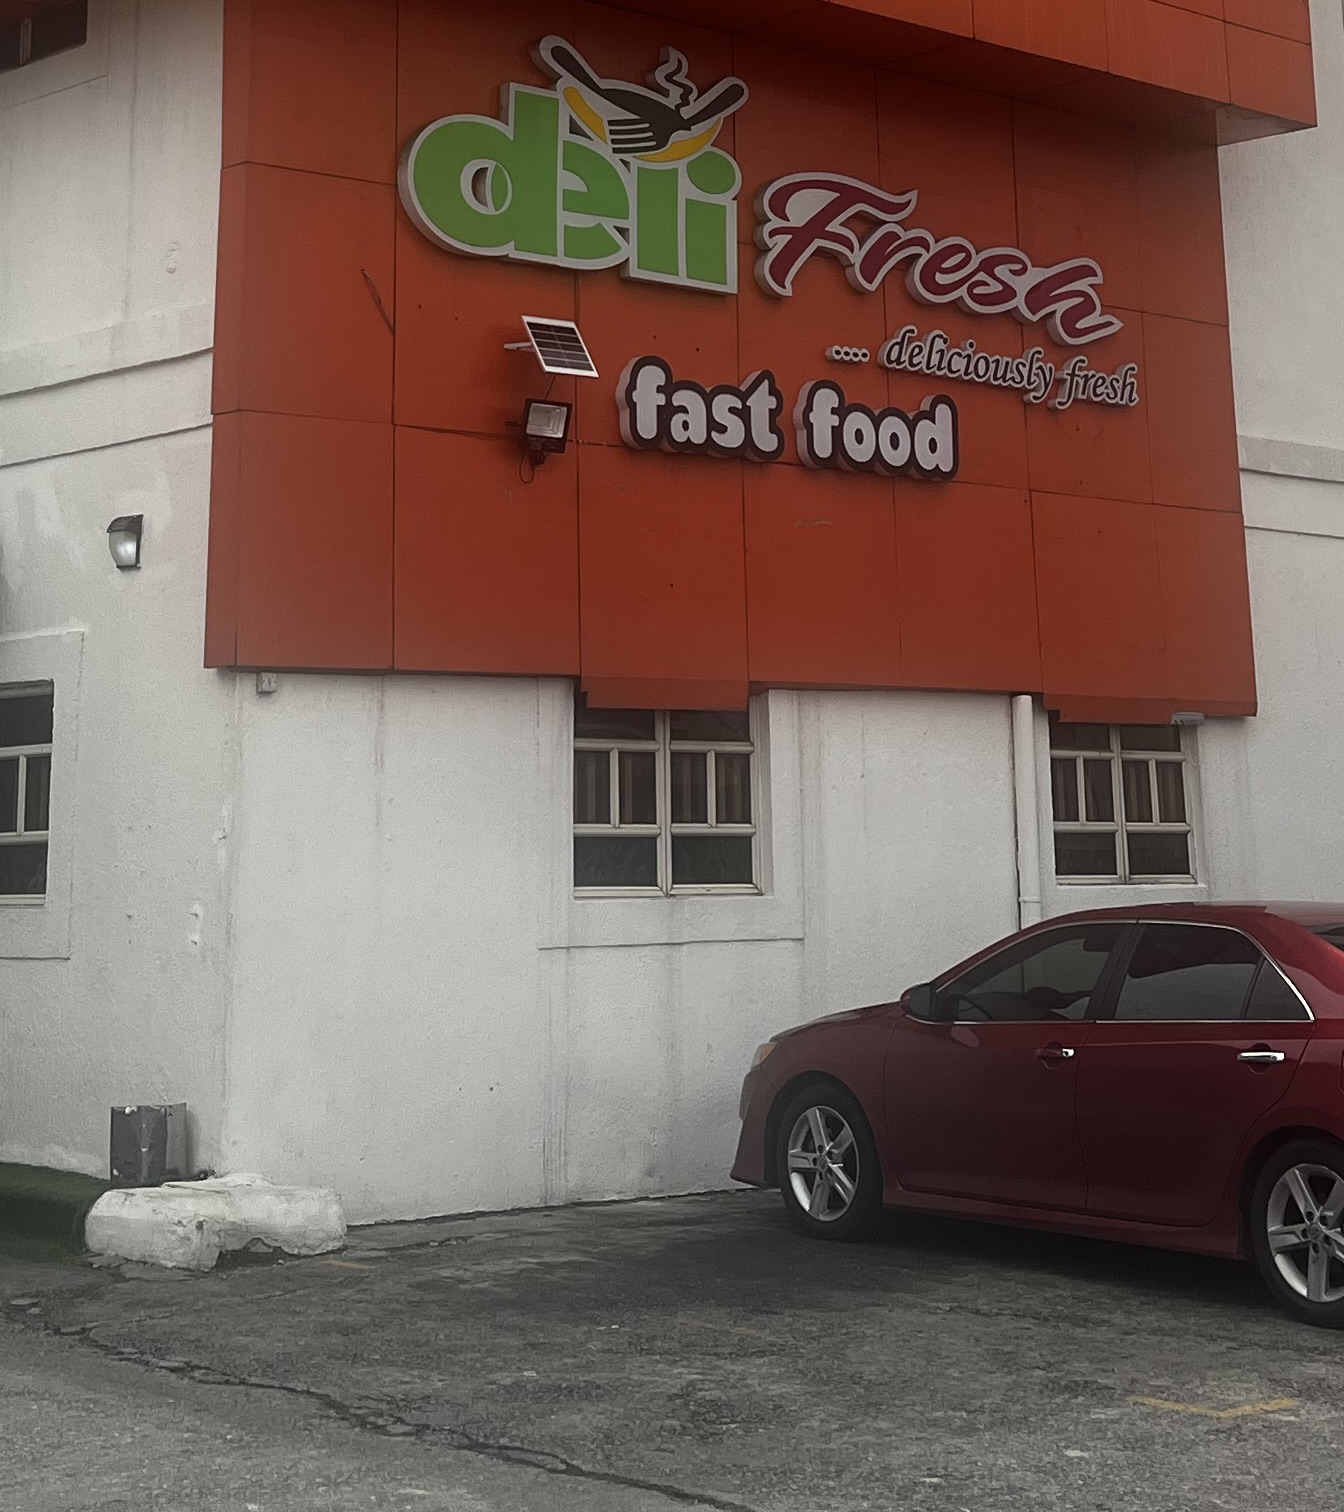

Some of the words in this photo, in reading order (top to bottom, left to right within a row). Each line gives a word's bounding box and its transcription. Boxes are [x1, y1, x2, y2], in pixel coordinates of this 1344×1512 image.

[398, 82, 742, 295] deli
[753, 171, 1125, 347] Fresh
[617, 355, 784, 462] fast
[795, 378, 960, 480] food
[878, 325, 1053, 402] deliciously
[1049, 356, 1140, 409] fresh
